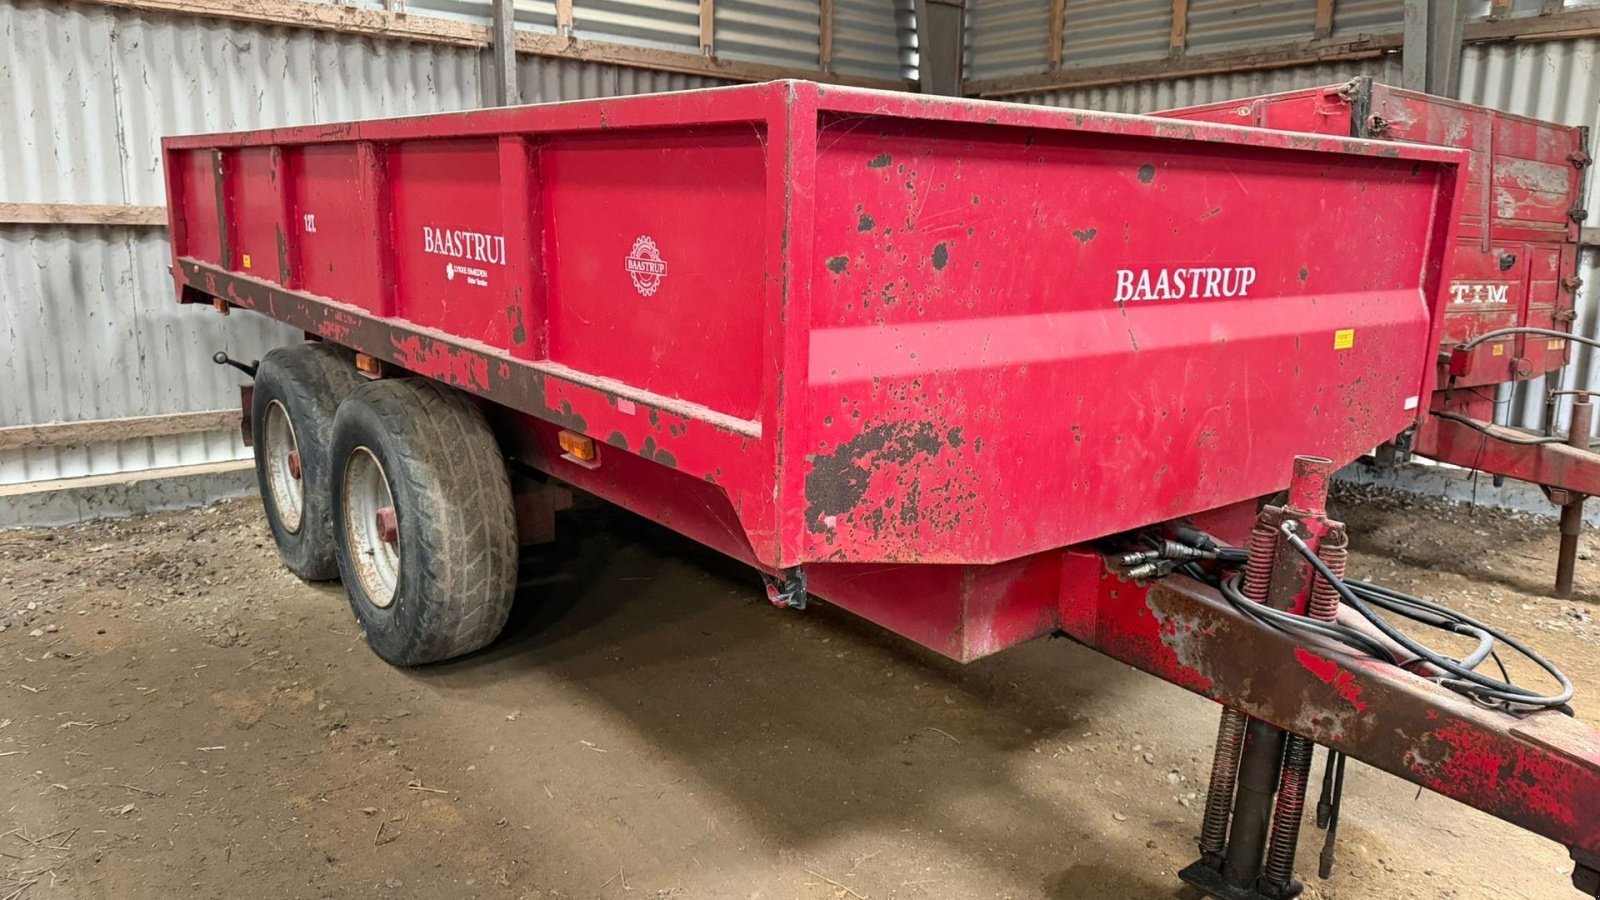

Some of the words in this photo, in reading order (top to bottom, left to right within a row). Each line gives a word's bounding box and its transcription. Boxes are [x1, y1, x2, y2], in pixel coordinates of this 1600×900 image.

[627, 259, 665, 274] BAASTRUP
[1113, 266, 1256, 302] BAASTRUP
[1450, 284, 1509, 304] TIM
